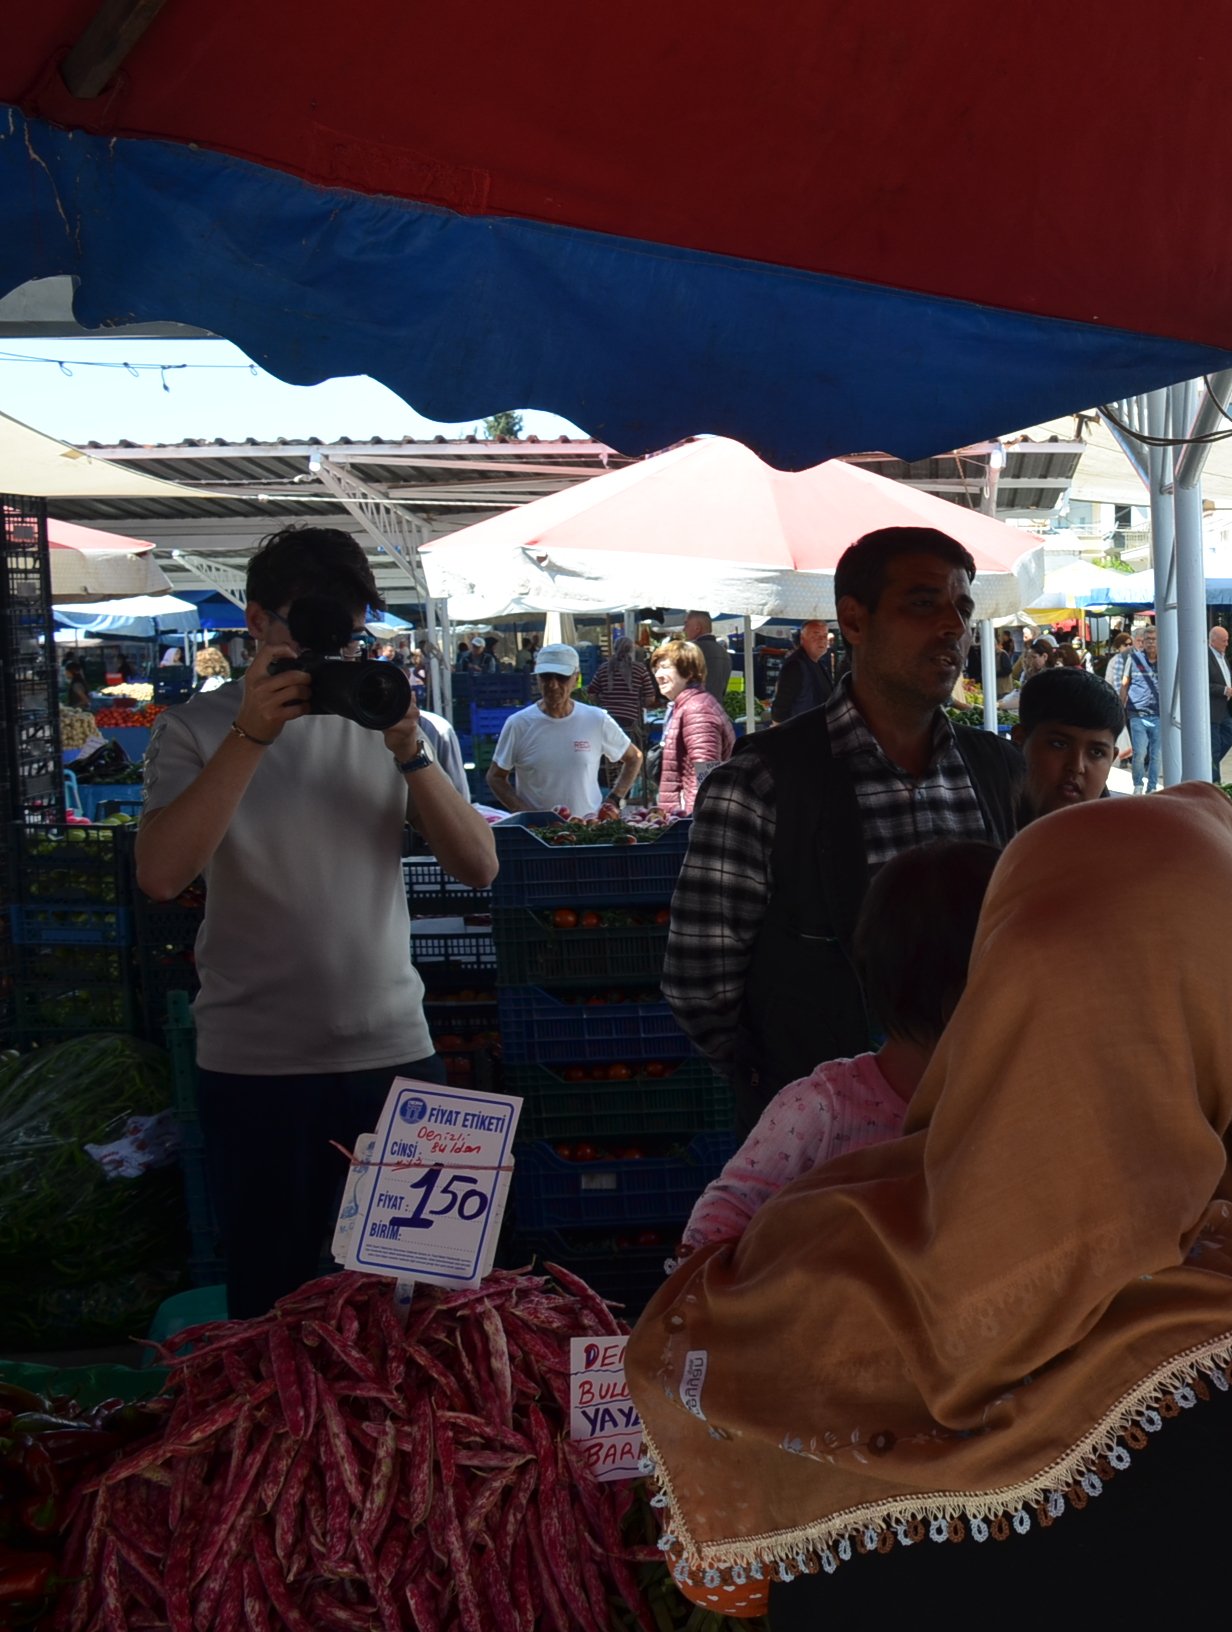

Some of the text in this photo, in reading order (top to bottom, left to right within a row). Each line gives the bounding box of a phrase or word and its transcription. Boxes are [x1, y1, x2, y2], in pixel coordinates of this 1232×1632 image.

[428, 1105, 506, 1133] FİYAT ETİKETİ
[389, 1162, 489, 1229] 150
